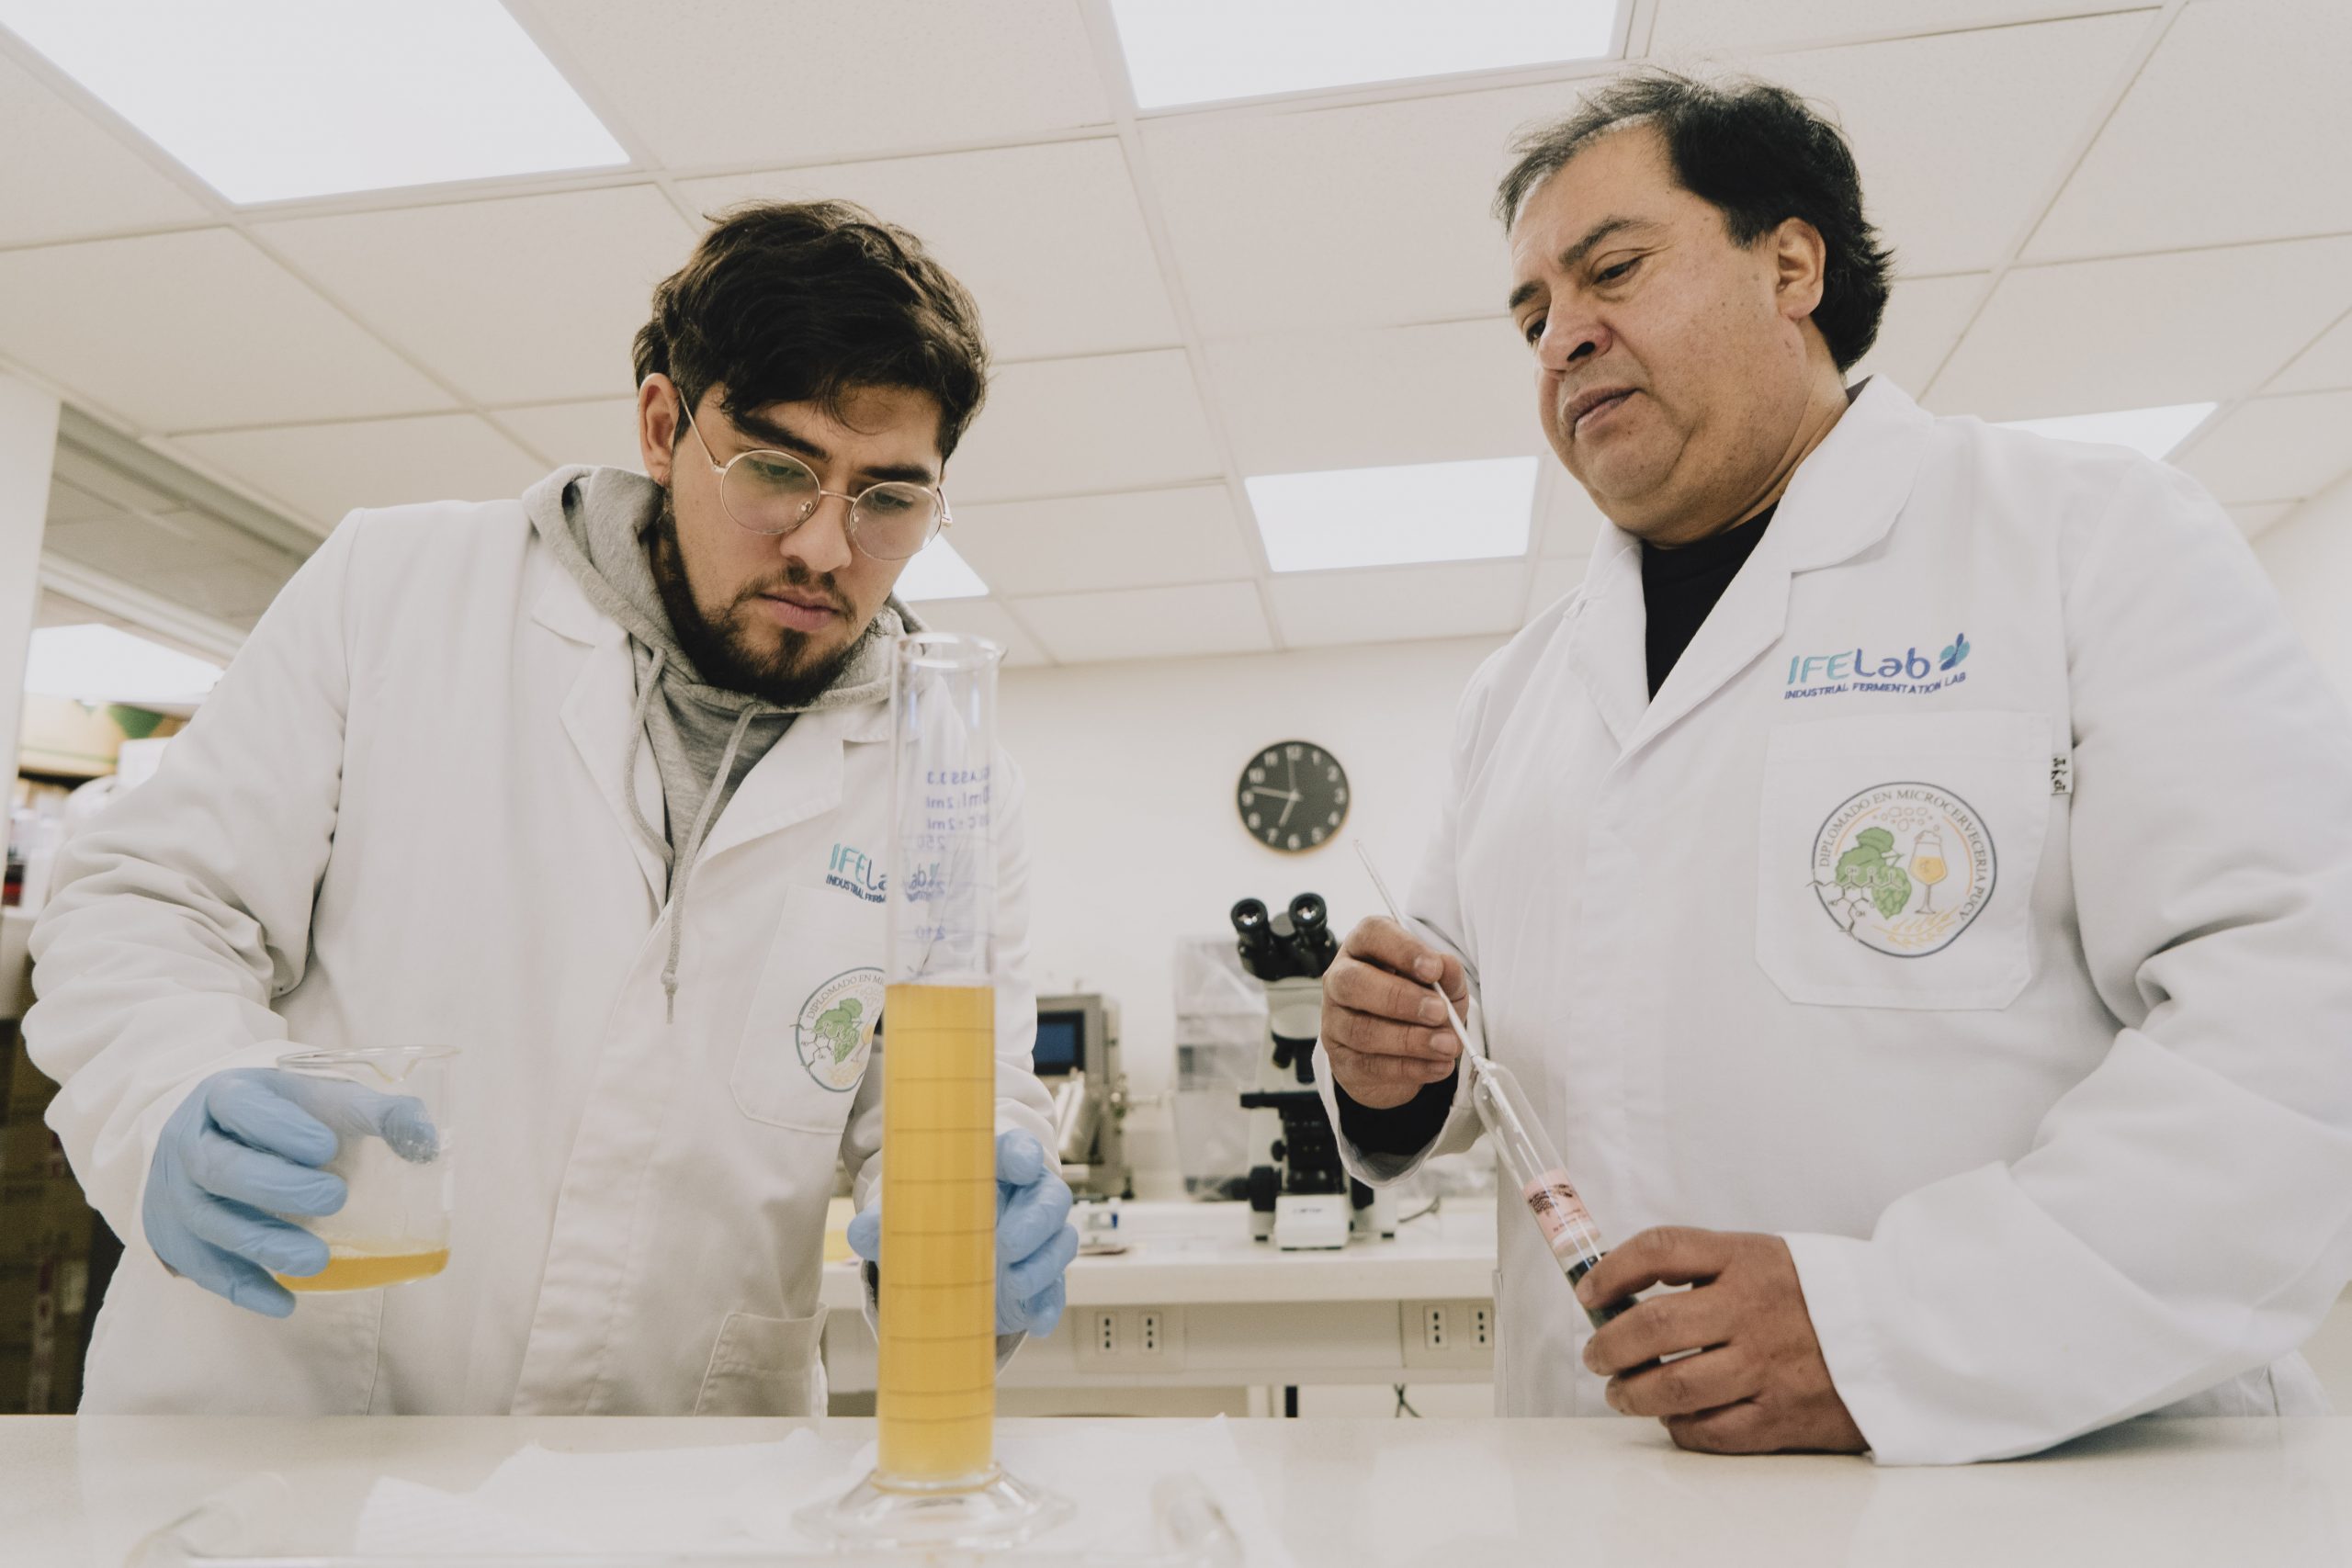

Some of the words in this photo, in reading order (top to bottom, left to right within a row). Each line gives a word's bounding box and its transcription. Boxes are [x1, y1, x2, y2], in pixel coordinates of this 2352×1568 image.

[1784, 683, 1849, 700] INDUSTRIAL
[1852, 680, 1941, 695] FERMENTATION
[1945, 671, 1966, 687] LAB
[1787, 648, 1930, 685] IFELab
[829, 843, 887, 891] IFELa
[1819, 798, 1871, 868] DIPLOMADO
[1872, 790, 1893, 805] EN
[1896, 789, 1987, 883] MICROCERVECERIA
[1959, 885, 1985, 921] PUCV
[807, 976, 857, 1020] DIPLOMADO
[859, 975, 870, 983] EN
